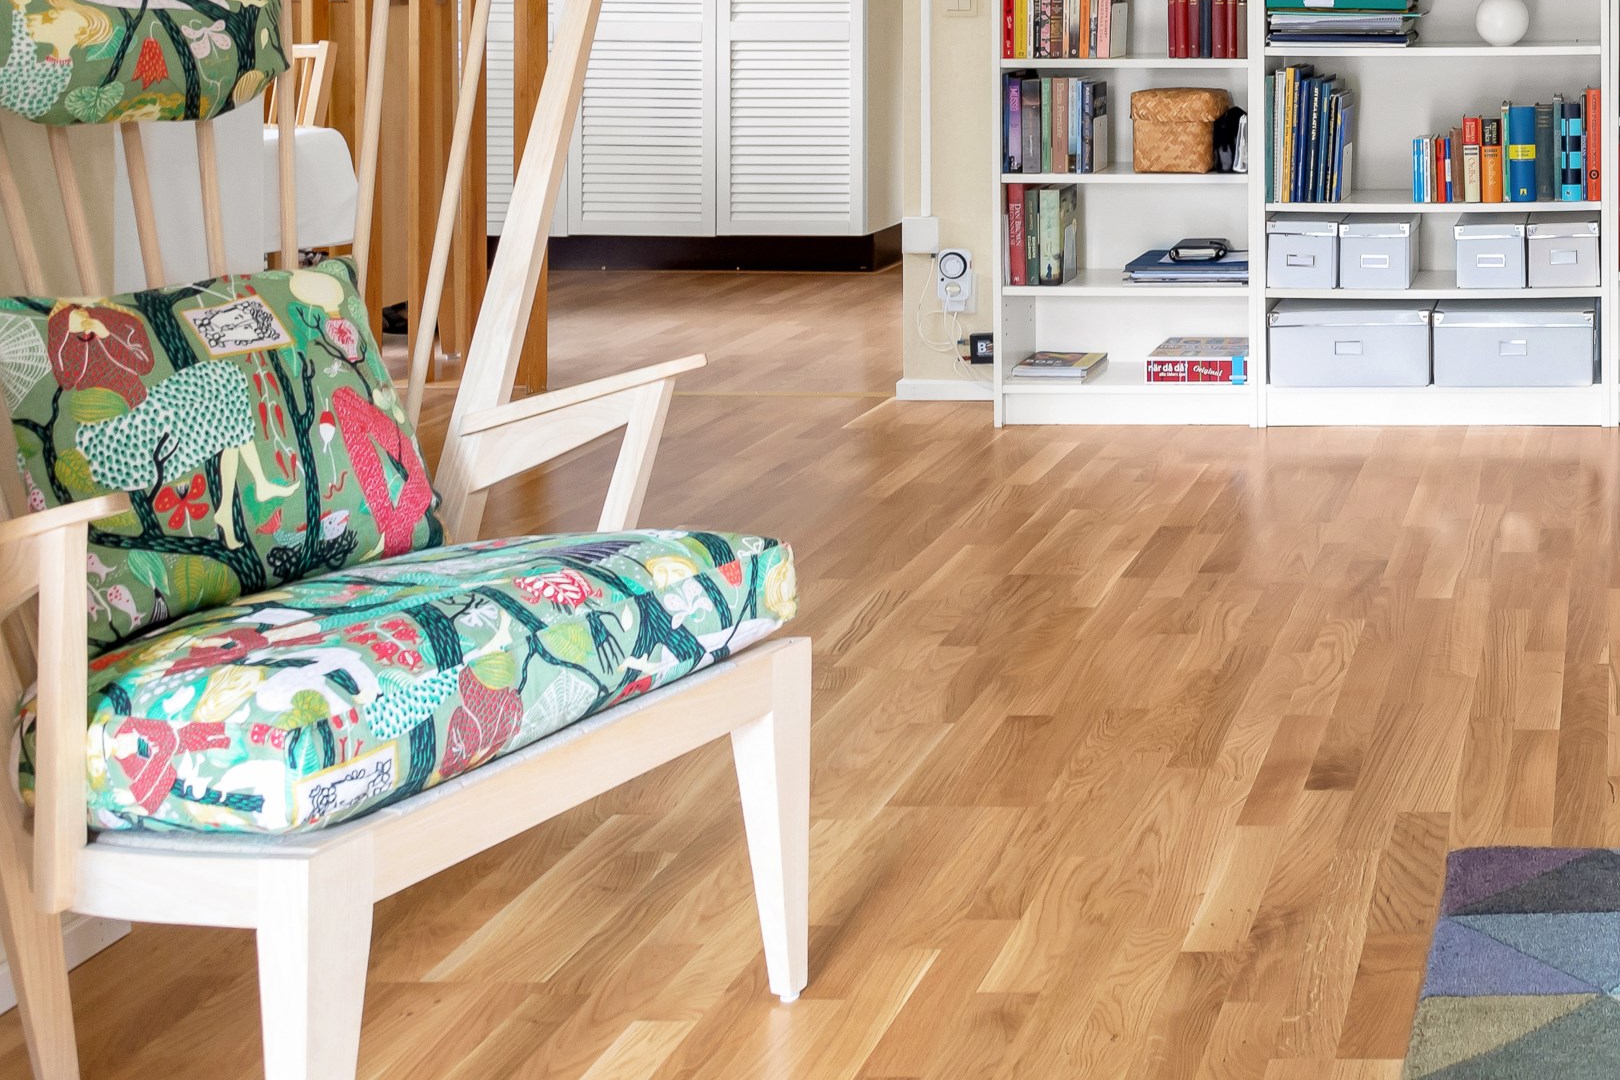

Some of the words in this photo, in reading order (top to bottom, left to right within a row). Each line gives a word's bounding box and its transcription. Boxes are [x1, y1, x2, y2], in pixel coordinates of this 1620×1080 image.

[1484, 126, 1492, 142] Tyska
[1468, 158, 1476, 184] Ordbok
[1488, 160, 1496, 186] Ordbok
[1148, 364, 1162, 372] när
[1163, 363, 1173, 372] då
[1193, 365, 1223, 377] Original
